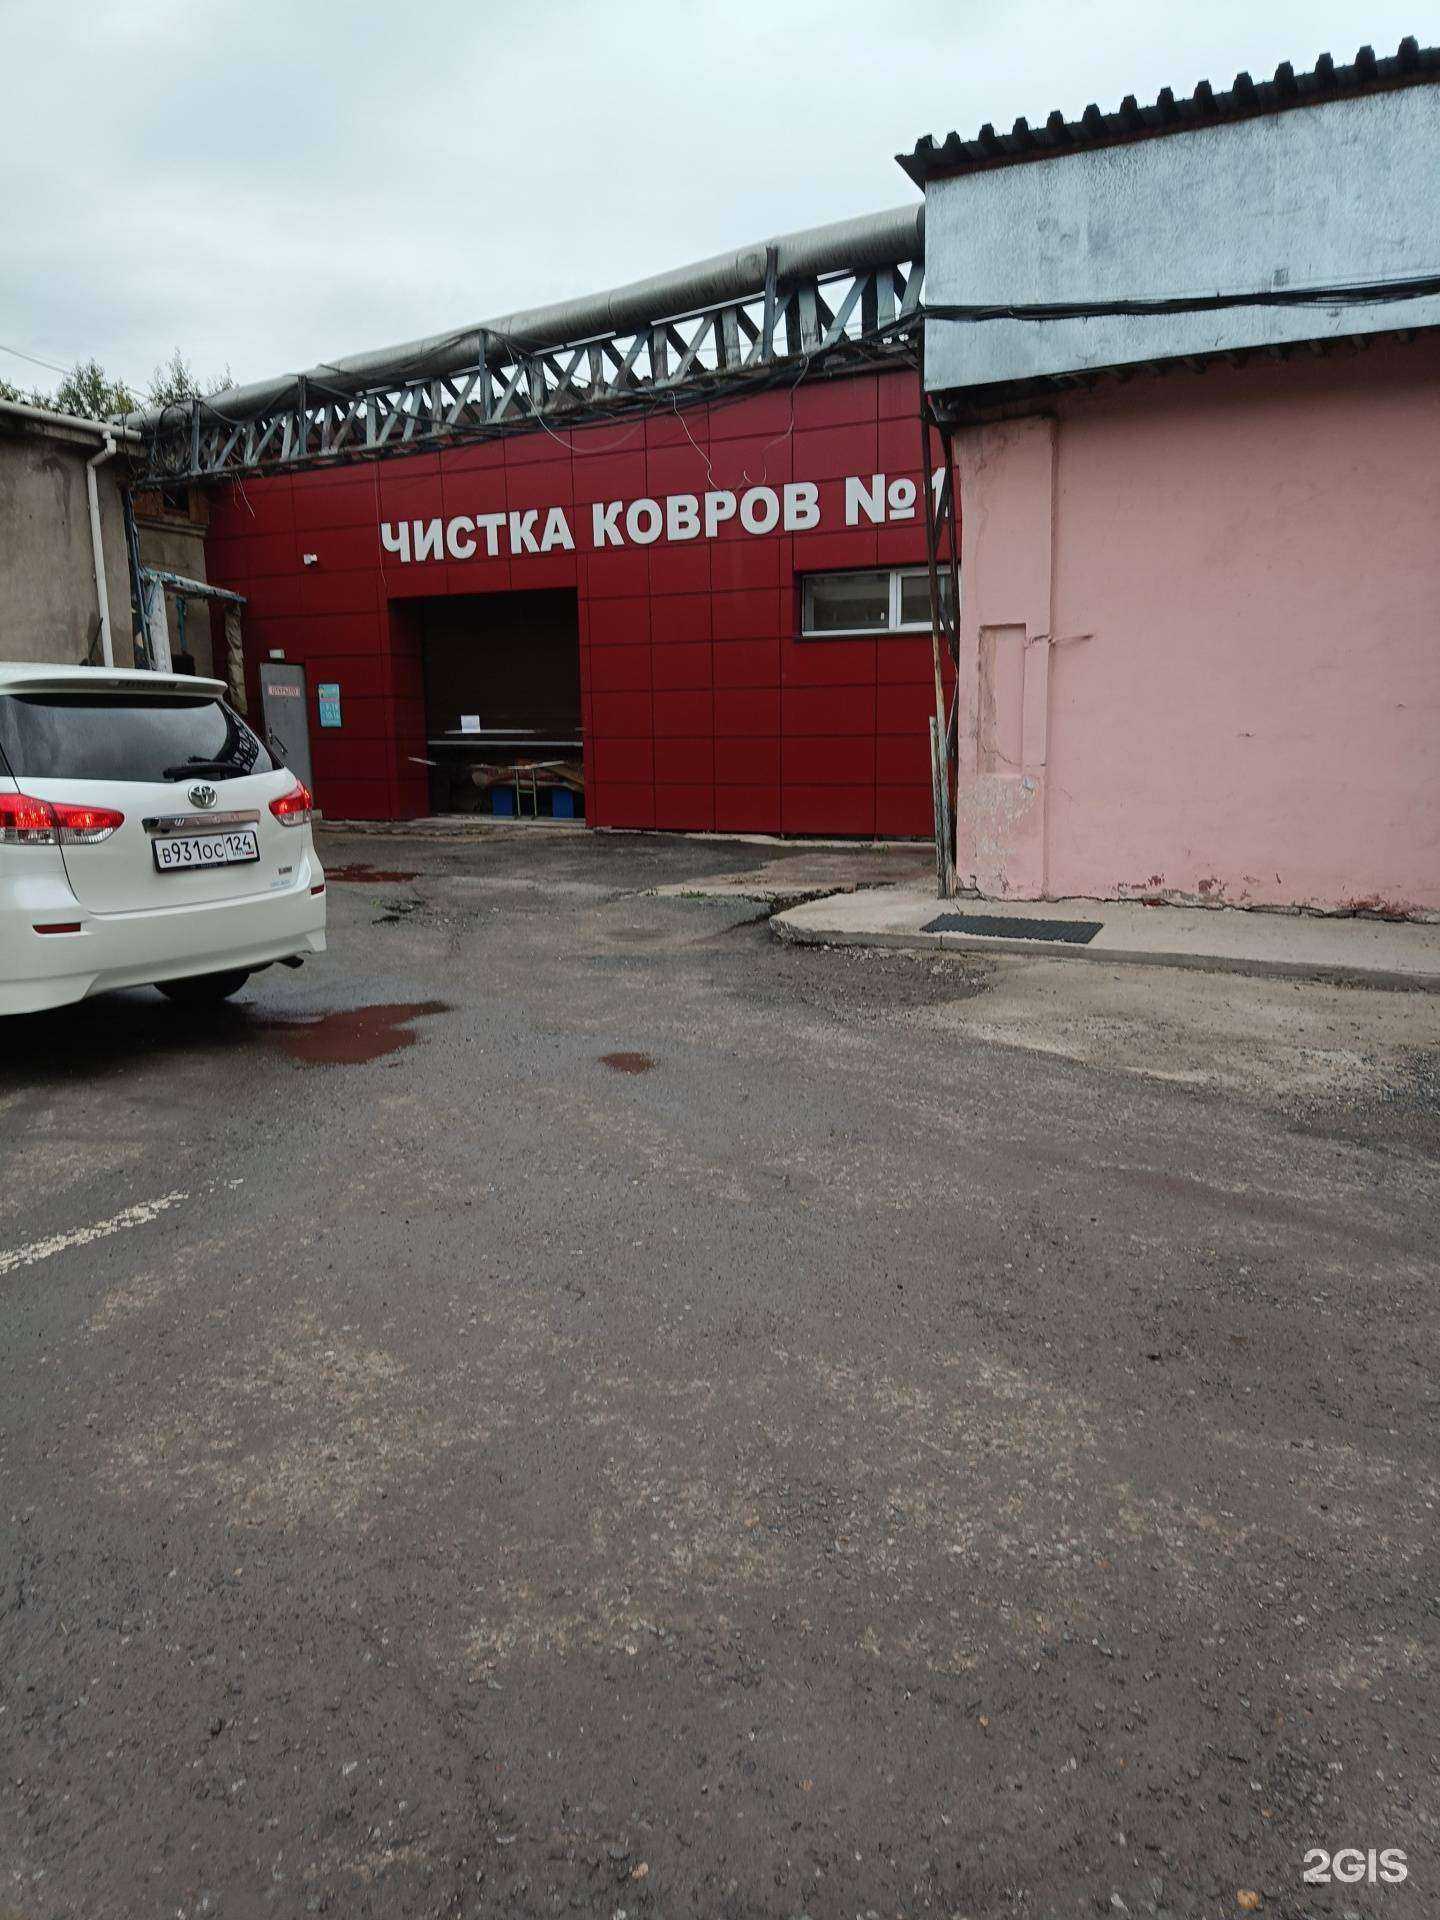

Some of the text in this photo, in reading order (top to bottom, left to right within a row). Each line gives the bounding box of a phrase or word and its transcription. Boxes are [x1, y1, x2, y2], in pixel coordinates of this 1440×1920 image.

[380, 506, 576, 564] ЧИСТКА
[592, 481, 821, 548] КОВРОВ
[225, 834, 252, 852] 124
